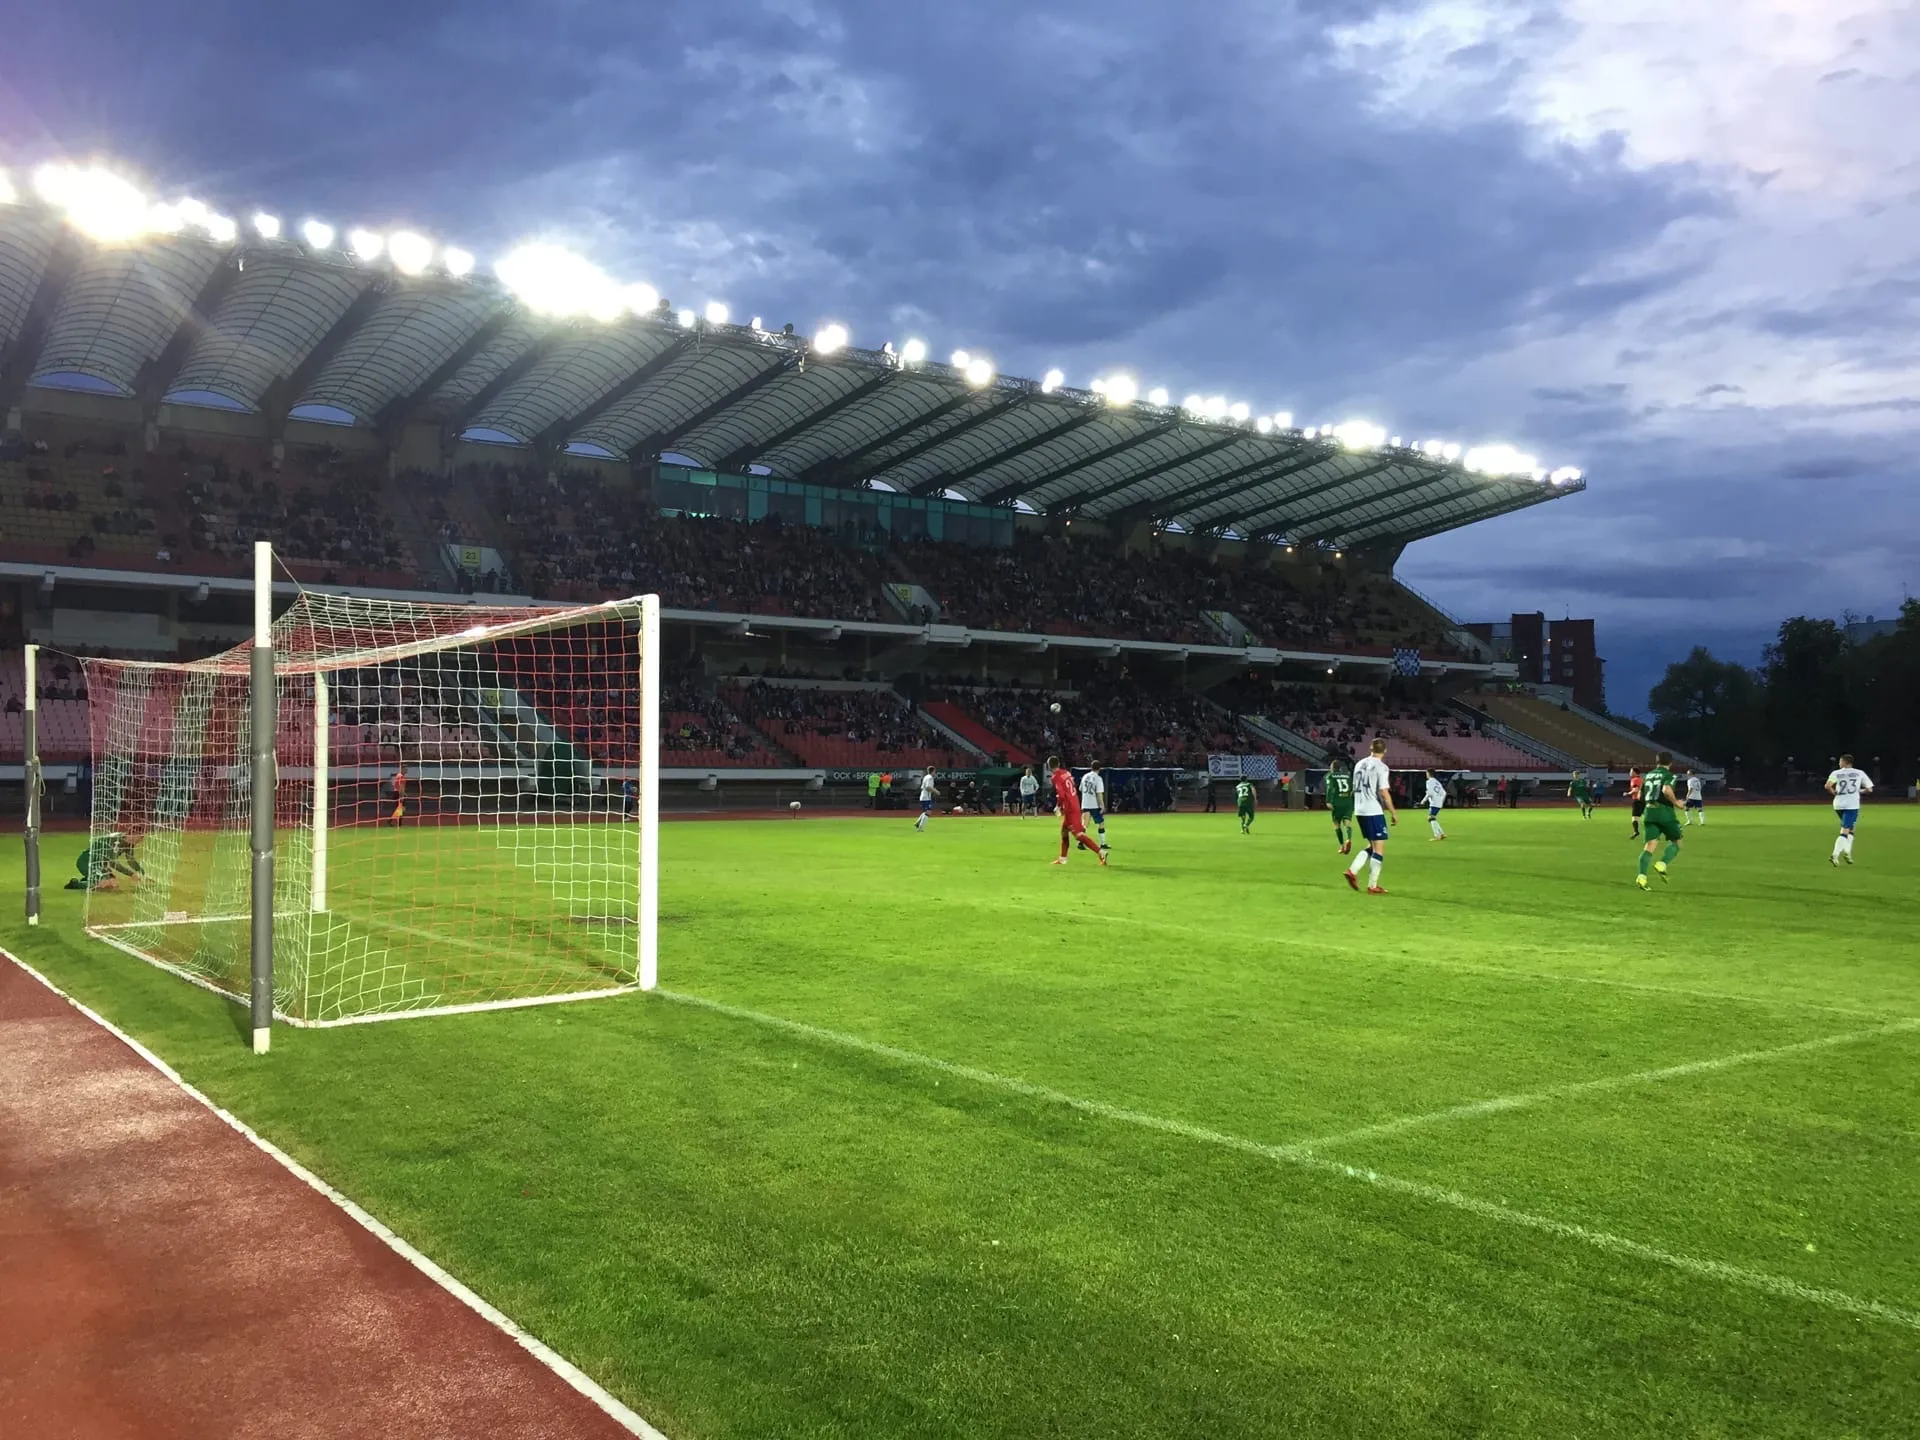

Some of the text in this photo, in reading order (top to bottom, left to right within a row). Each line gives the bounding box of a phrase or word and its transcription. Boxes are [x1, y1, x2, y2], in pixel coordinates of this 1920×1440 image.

[1336, 779, 1349, 793] 13
[1645, 780, 1661, 801] 27
[1837, 779, 1858, 795] 23
